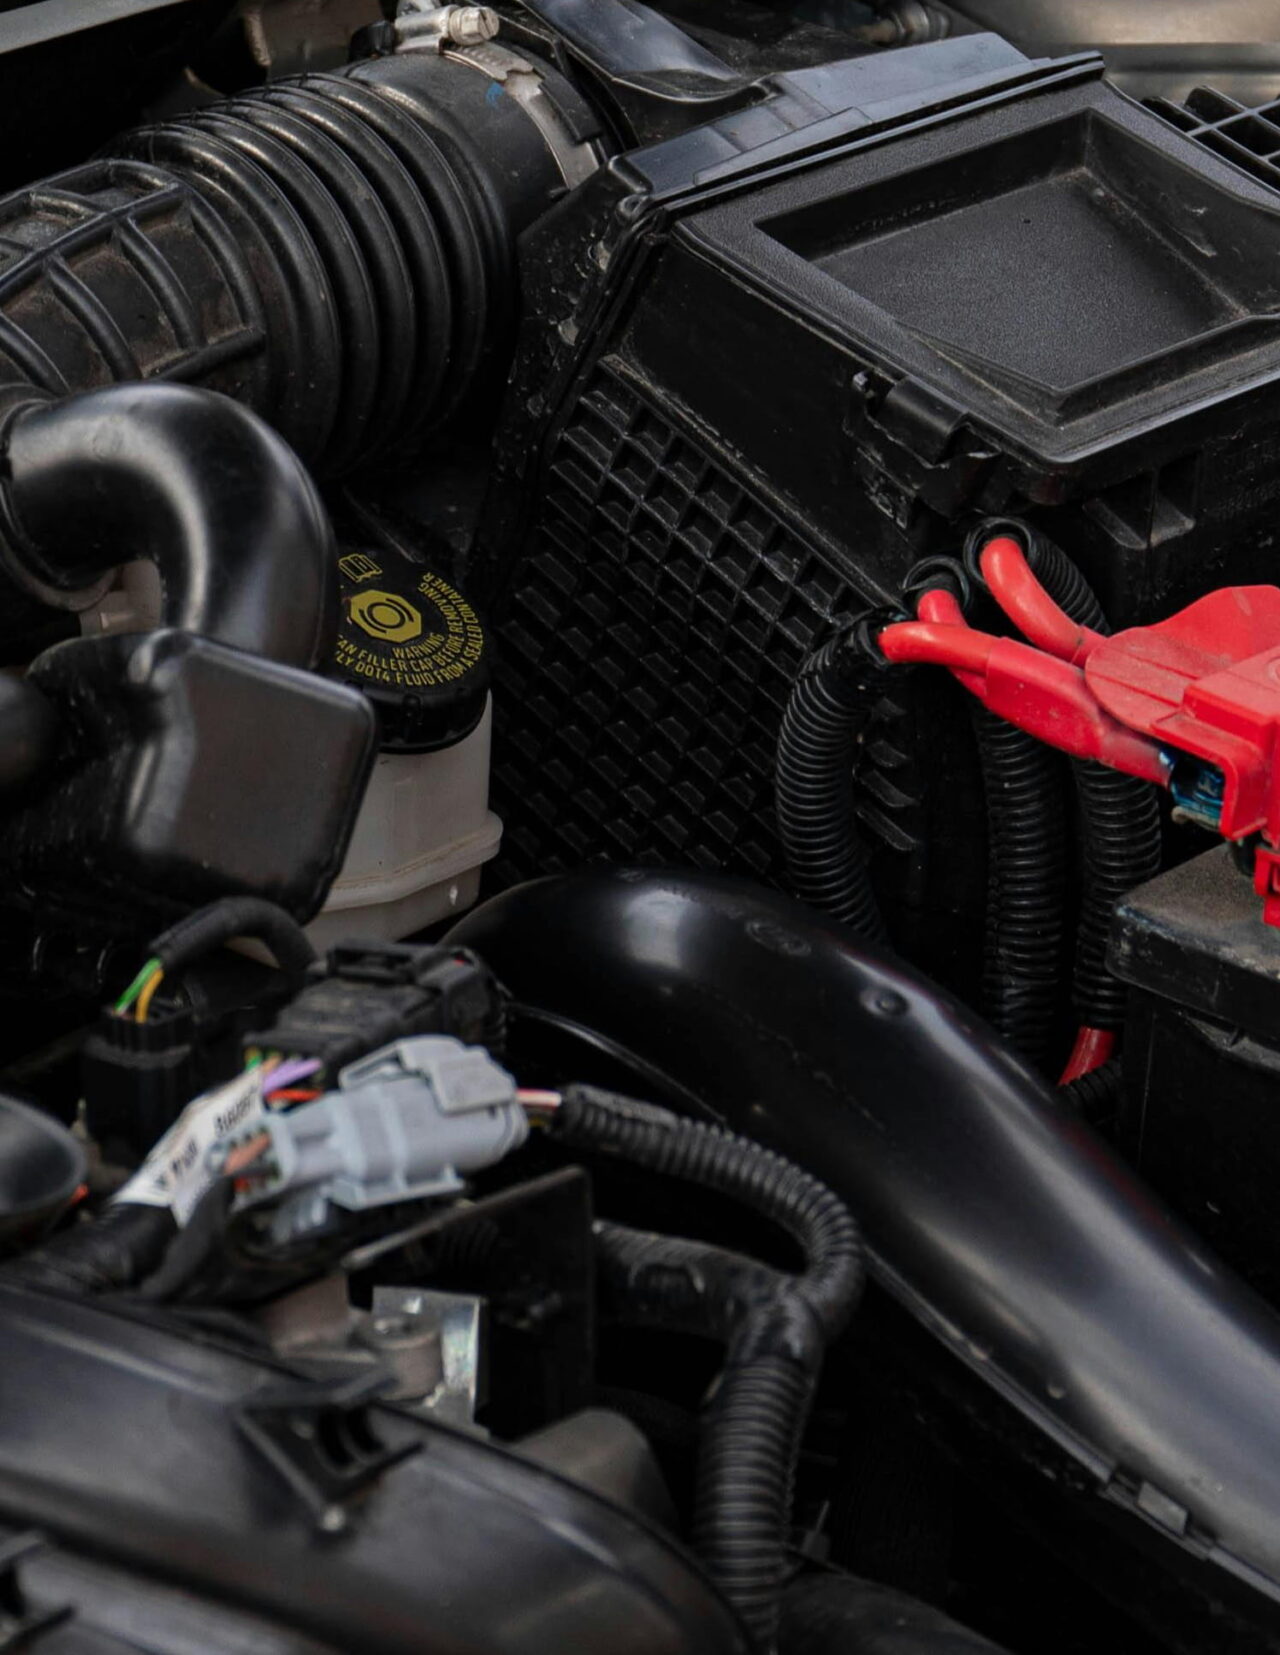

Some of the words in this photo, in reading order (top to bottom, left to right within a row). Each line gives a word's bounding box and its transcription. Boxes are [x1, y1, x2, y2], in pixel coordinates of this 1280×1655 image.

[418, 582, 464, 634] REMOVING
[422, 571, 479, 624] CONTAINER
[392, 632, 445, 660] WARNING
[432, 633, 465, 666] BEFORE
[464, 625, 484, 661] SEALED
[358, 649, 408, 672] FILLER
[410, 657, 434, 673] CAP
[433, 662, 465, 683] FROM
[396, 671, 435, 686] FLUID
